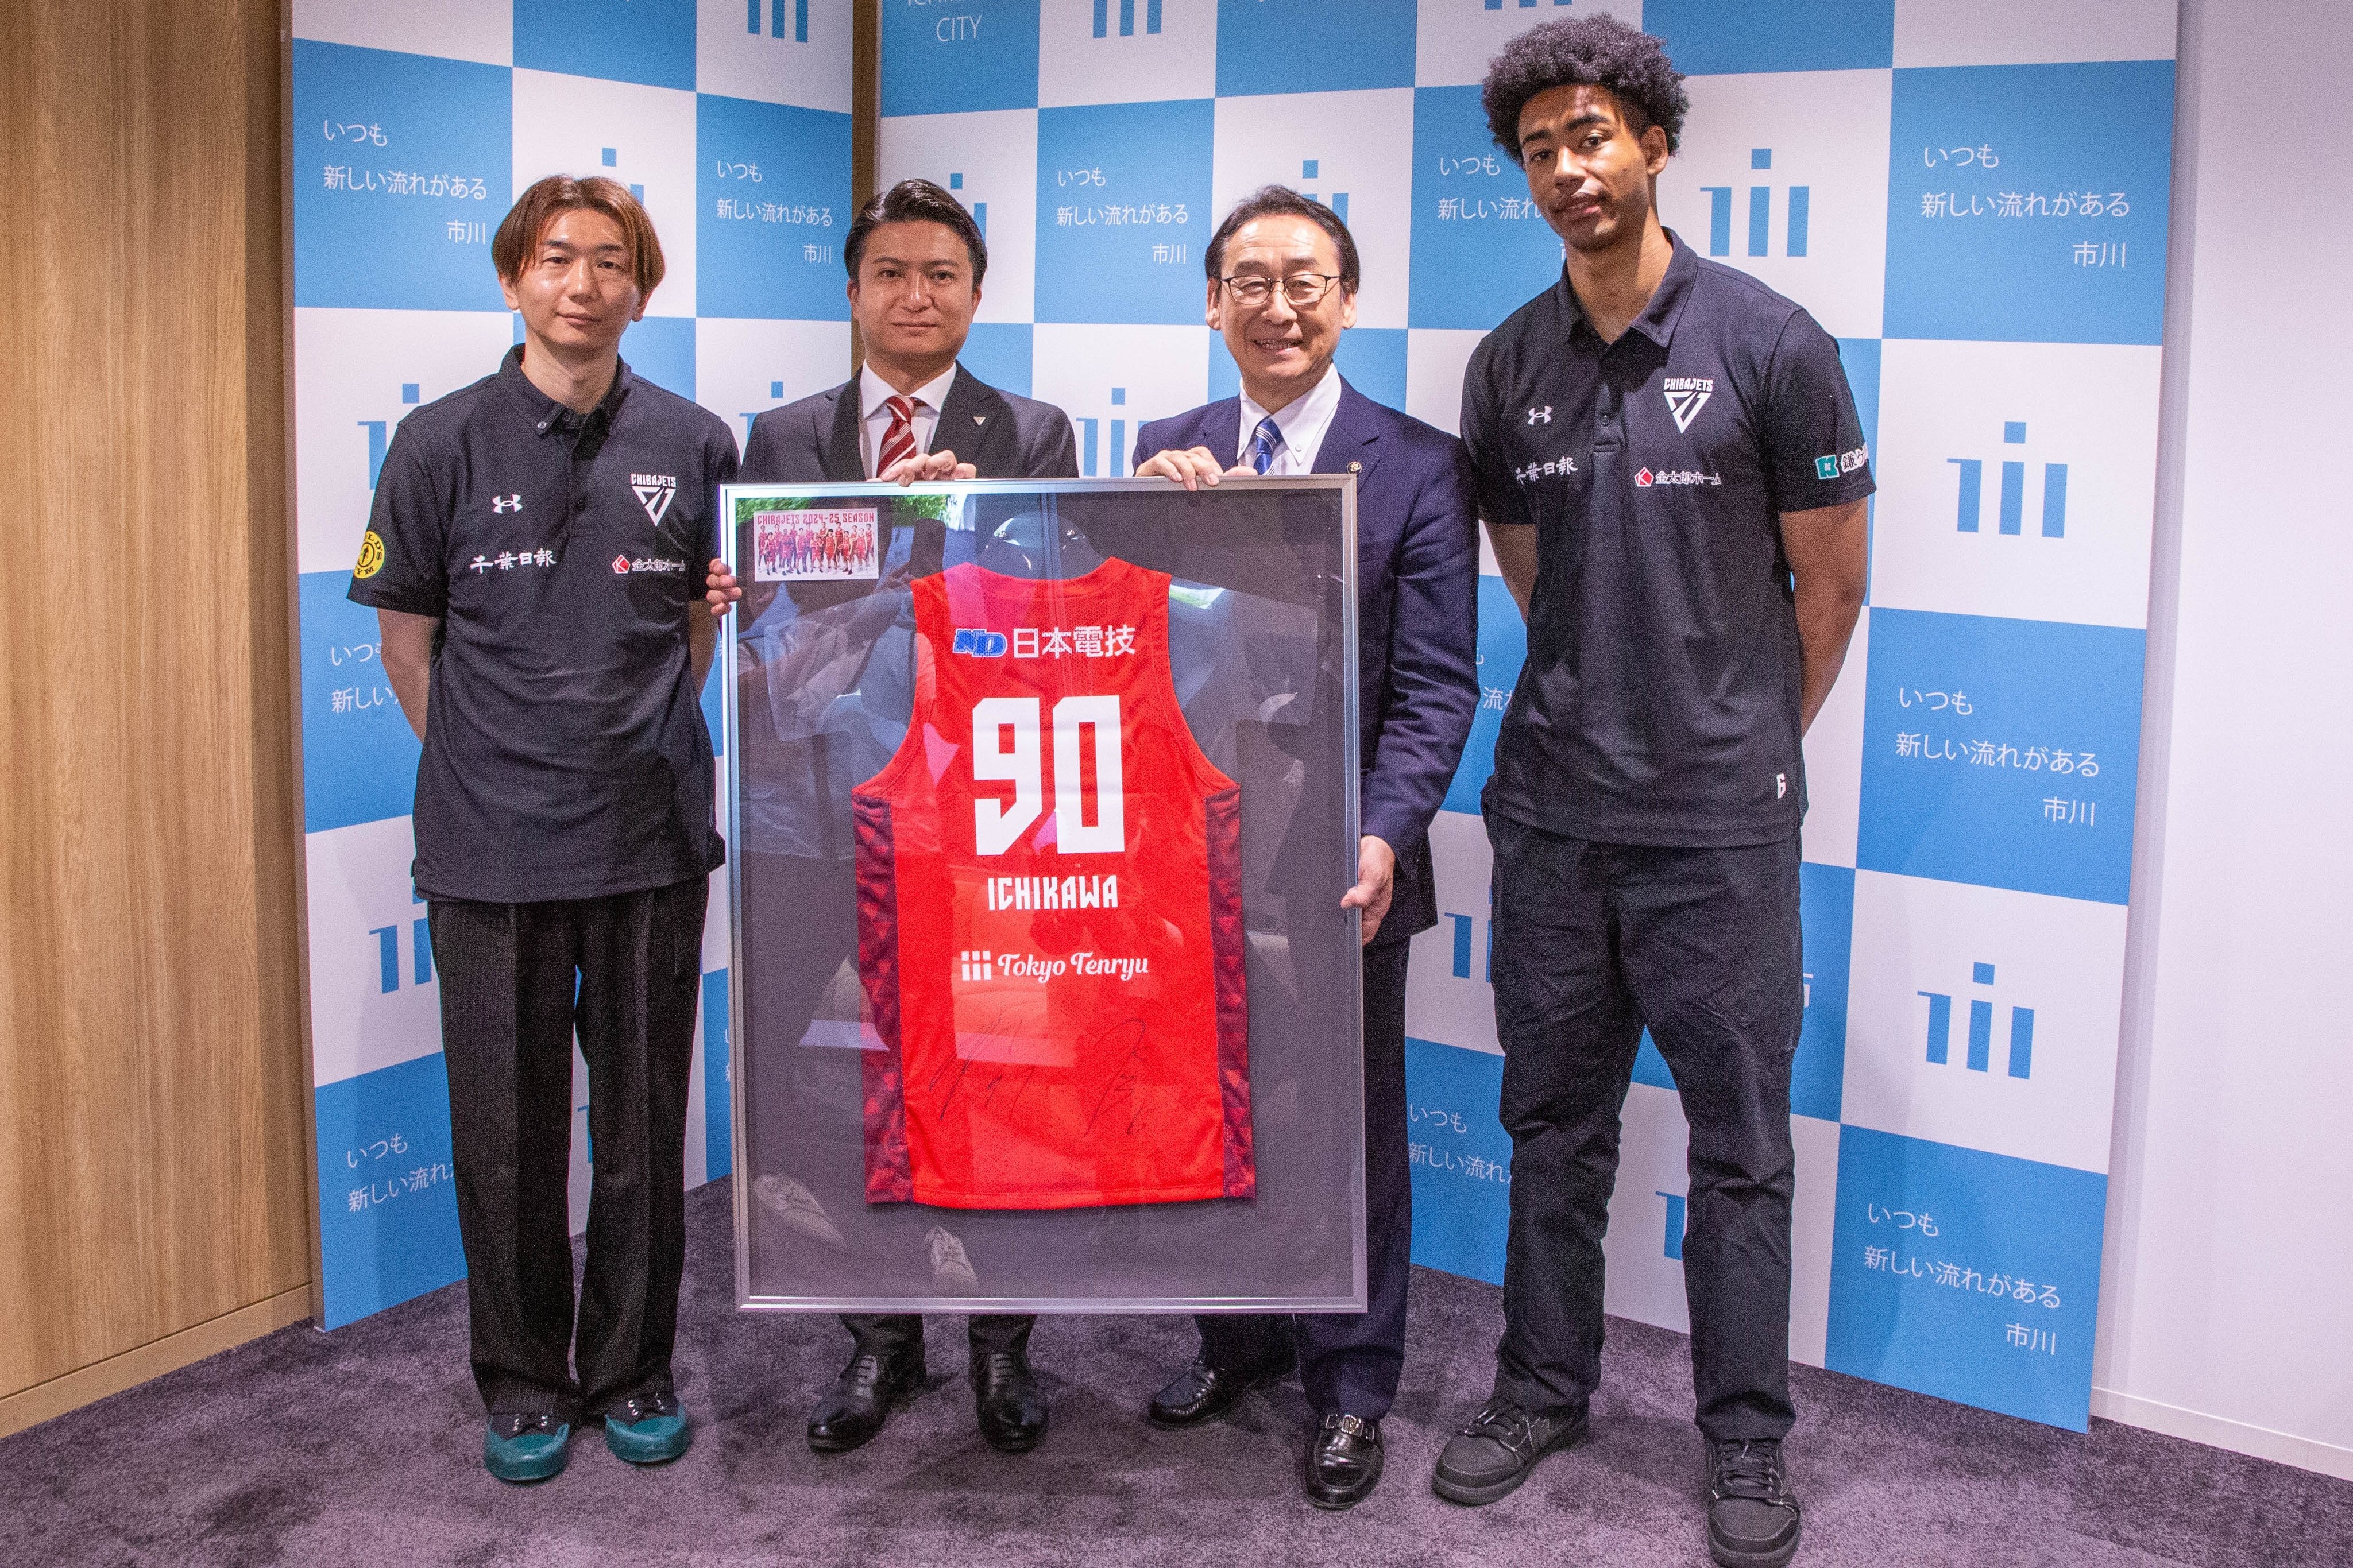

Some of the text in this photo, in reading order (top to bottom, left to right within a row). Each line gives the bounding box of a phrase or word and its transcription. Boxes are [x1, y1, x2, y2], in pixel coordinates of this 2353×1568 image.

[937, 15, 982, 42] CITY
[324, 120, 388, 147] いつも
[1440, 154, 1501, 176] いつも
[1924, 144, 1999, 168] いつも
[324, 164, 487, 201] 新しい流れがある
[717, 161, 762, 183] いつも
[1058, 167, 1106, 187] いつも
[717, 198, 832, 227] 新しい流れがある
[1056, 204, 1188, 227] 新しい流れがある
[1438, 196, 1543, 220] 新しい流れ
[1921, 192, 2130, 218] 新しい流れがある
[447, 220, 486, 245] 市川
[804, 243, 832, 265] 市川
[1152, 243, 1187, 265] 市川
[2072, 241, 2126, 268] 市川
[1663, 377, 1713, 392] CHIBAJETS
[631, 473, 676, 487] CHIBAJETS
[1655, 470, 1722, 485] 金太郎ホーム
[758, 512, 874, 525] CHIBAJETS 2024-25 SEASON
[469, 548, 557, 574] 千葉日報
[331, 643, 381, 667] いつ
[1013, 624, 1136, 659] 日本電技
[1899, 687, 1973, 715] いつも
[1895, 731, 2100, 777] 新しい流れがある
[972, 695, 1125, 855] 90
[2042, 796, 2095, 827] 市川
[988, 875, 1118, 911] ICHIKAWA
[997, 951, 1149, 984] Tokyo Tenryu
[1409, 1104, 1467, 1133] いつも
[346, 1133, 408, 1168] いつも
[1409, 1141, 1512, 1183] 新しい流れ
[348, 1162, 454, 1213] 新しい流れ
[1868, 1203, 1939, 1237] いつも
[1864, 1245, 2061, 1310] 新しい流れがある
[2005, 1322, 2057, 1356] 市川
